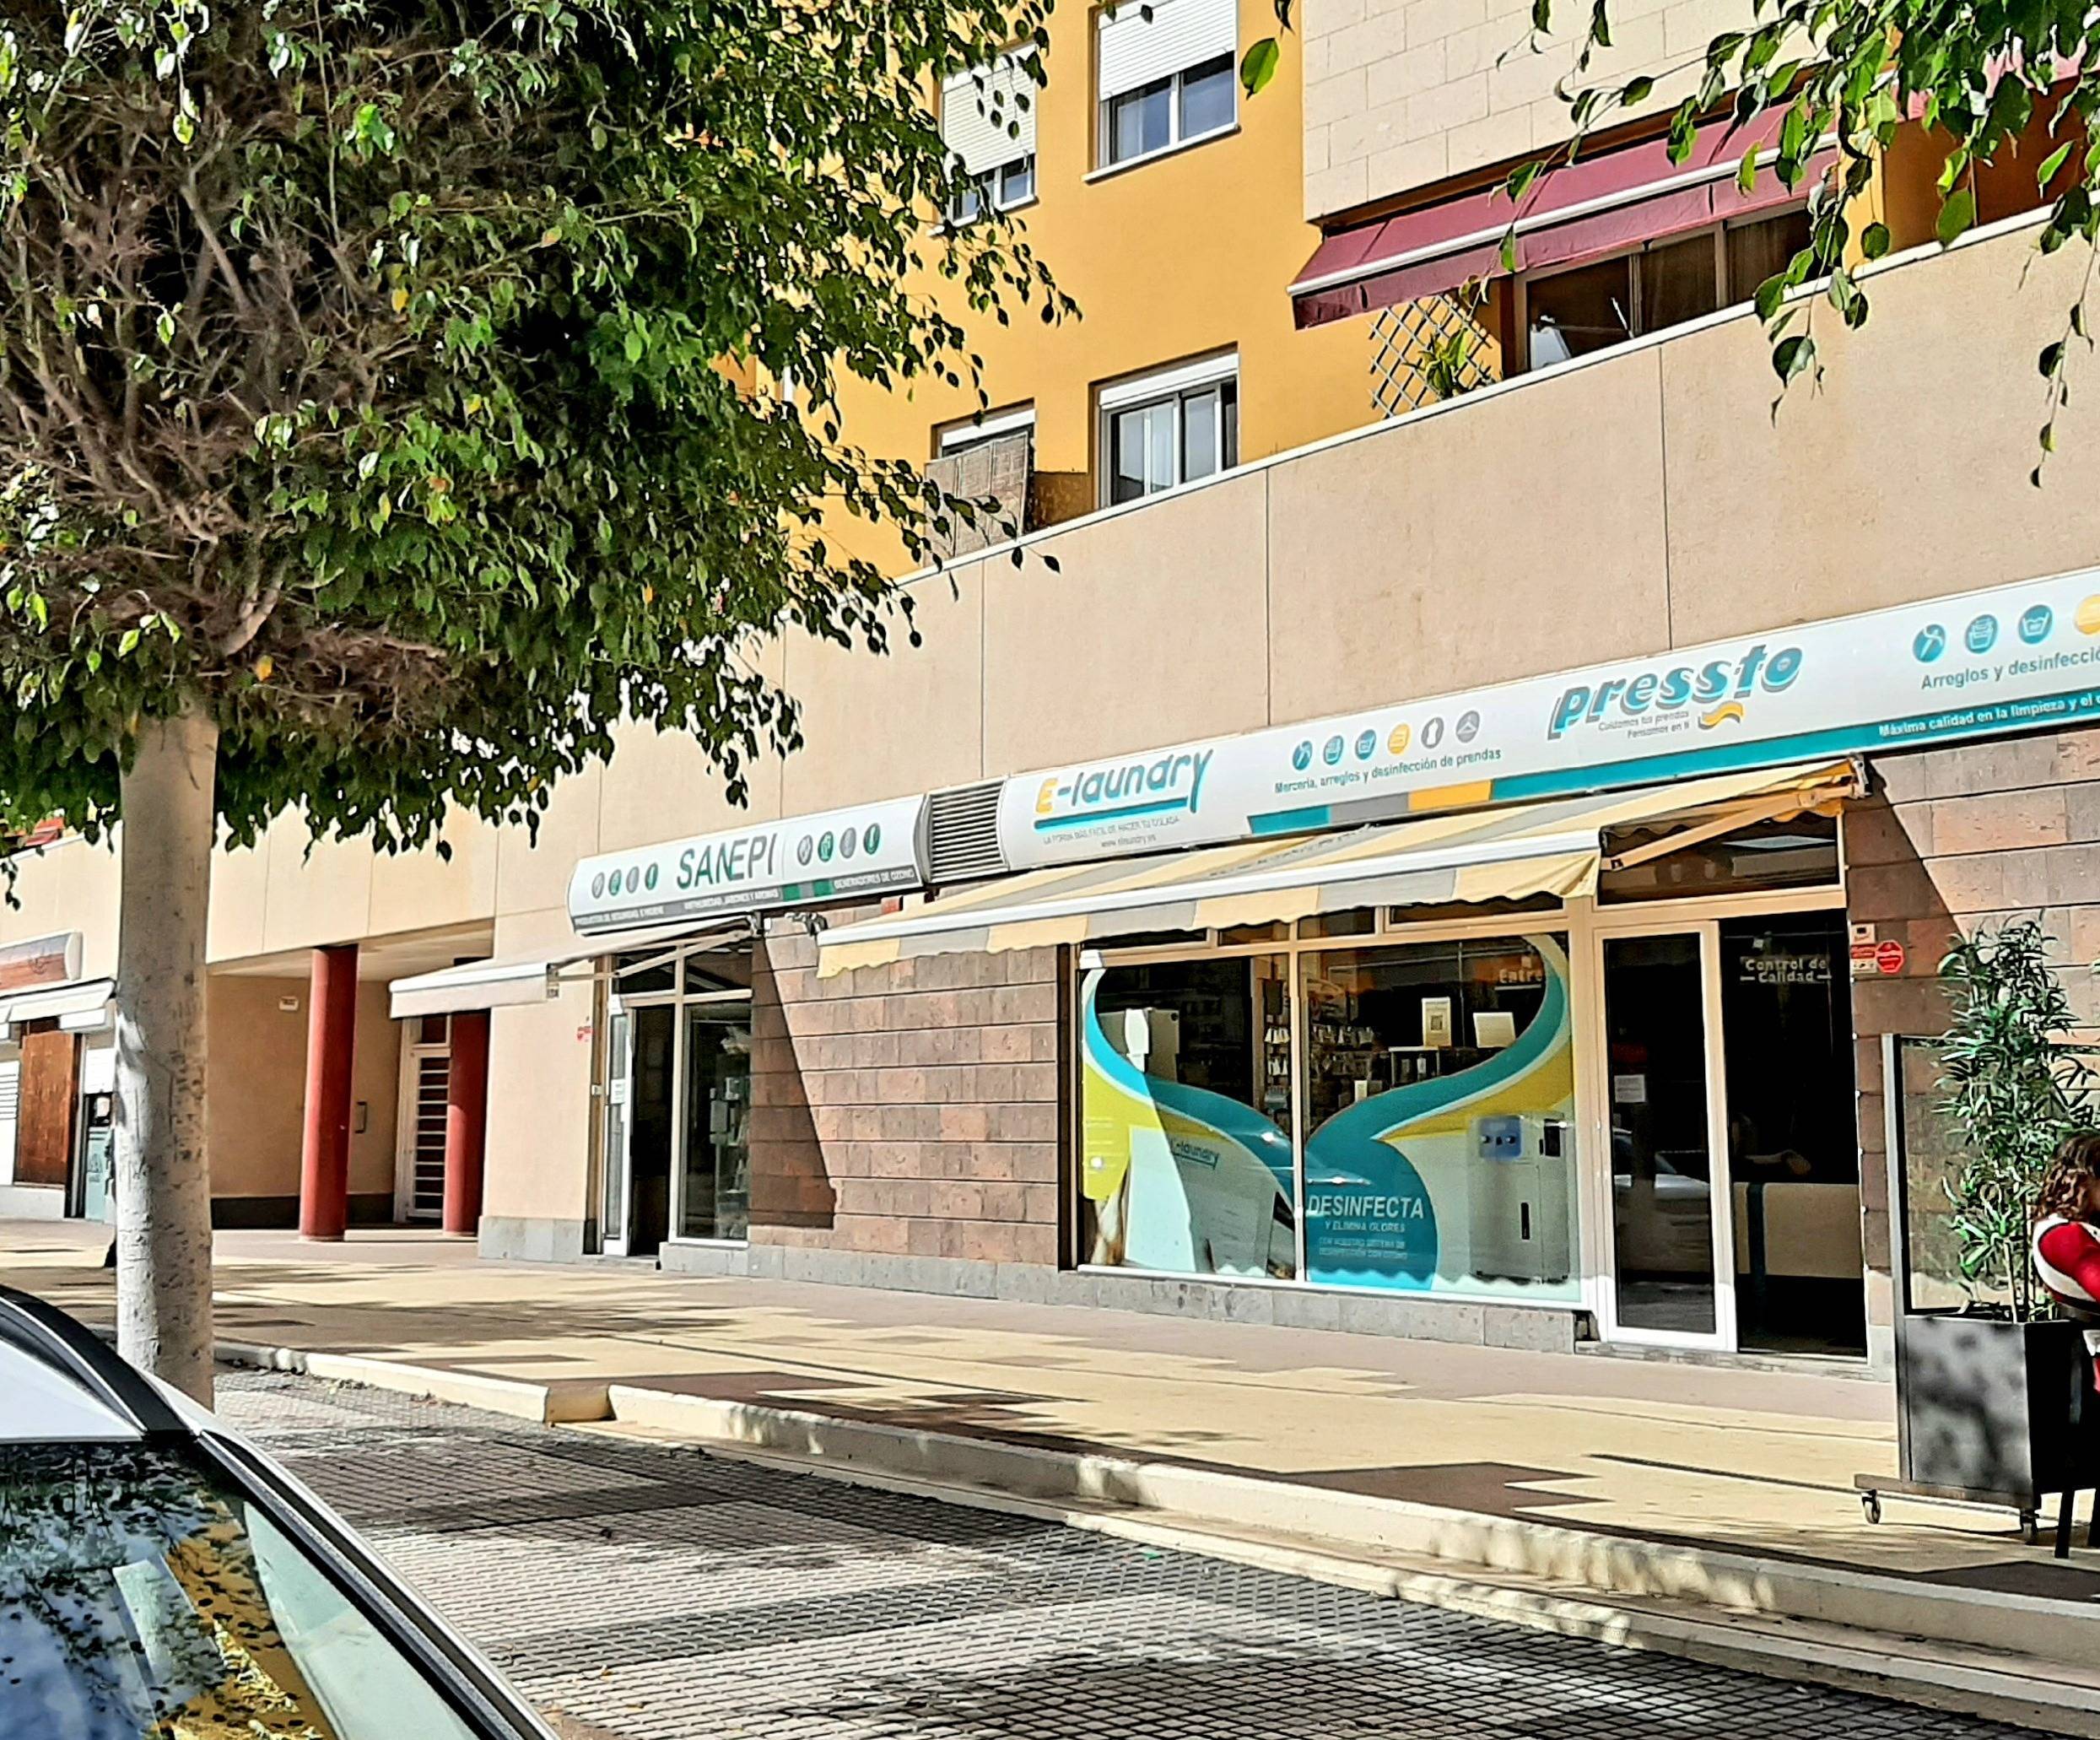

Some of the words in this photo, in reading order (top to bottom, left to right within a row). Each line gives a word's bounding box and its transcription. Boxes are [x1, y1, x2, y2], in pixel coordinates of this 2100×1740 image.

[1547, 644, 1804, 741] pressto
[1921, 668, 1989, 690] Arreglos
[1994, 666, 2004, 682] y
[1879, 720, 1926, 738] Máxima
[1929, 710, 1974, 731] calidad
[1977, 708, 1994, 721] en
[1995, 706, 2008, 720] la
[2011, 700, 2065, 718] limpieza
[2068, 698, 2077, 711] y
[2080, 693, 2093, 706] el
[1034, 748, 1213, 813] E-laundry
[1320, 768, 1361, 789] arreglos
[1363, 769, 1370, 784] y
[1371, 756, 1438, 779] desinfección
[1439, 752, 1454, 768] de
[1456, 748, 1502, 770] prendas
[676, 833, 777, 889] SANEPI
[1745, 958, 1804, 971] Control
[1808, 957, 1827, 970] de
[1757, 971, 1815, 983] Calidad
[1307, 1194, 1424, 1219] DESINFECTA
[1369, 1222, 1406, 1233] OLORES
